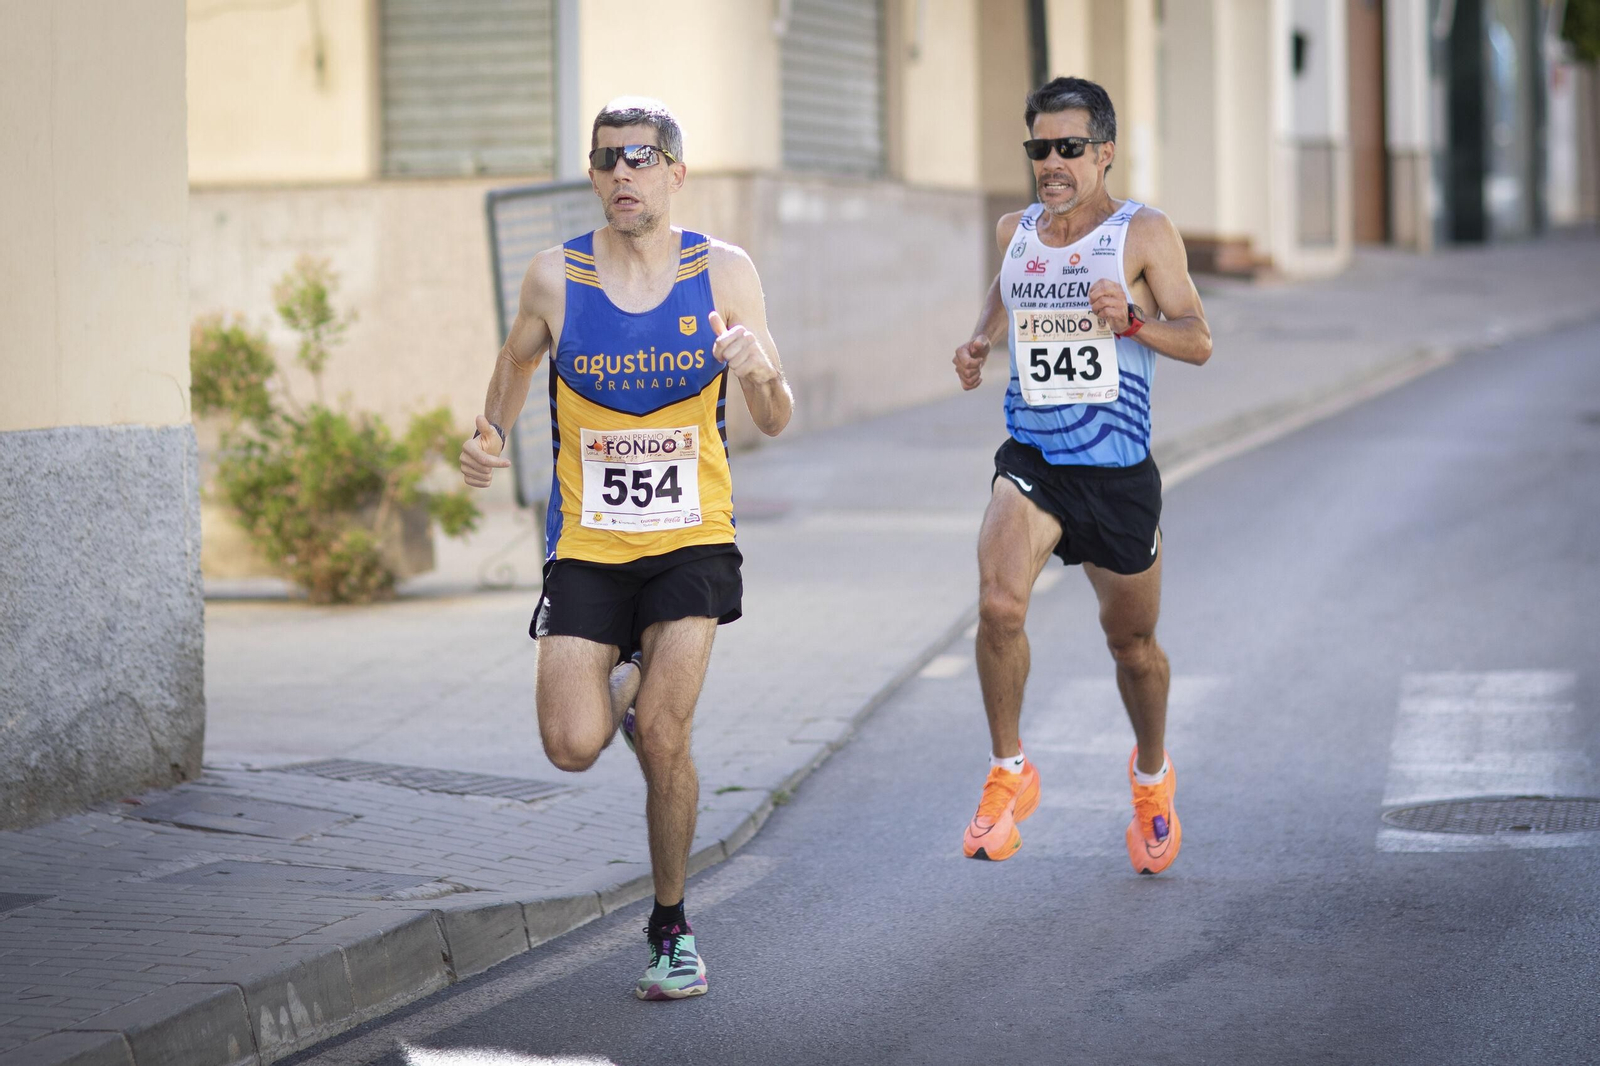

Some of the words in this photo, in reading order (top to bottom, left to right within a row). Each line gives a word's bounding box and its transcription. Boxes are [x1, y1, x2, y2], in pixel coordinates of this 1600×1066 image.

[1062, 266, 1089, 276] mayfo
[1011, 282, 1091, 299] MARACEN
[1033, 318, 1092, 334] FONDO
[573, 346, 705, 382] agustinos
[1030, 345, 1102, 382] 543
[595, 376, 687, 391] GRANADA
[606, 434, 631, 442] GRAN
[632, 432, 664, 441] PREMIO
[606, 438, 677, 456] FONDO
[602, 465, 682, 508] 554
